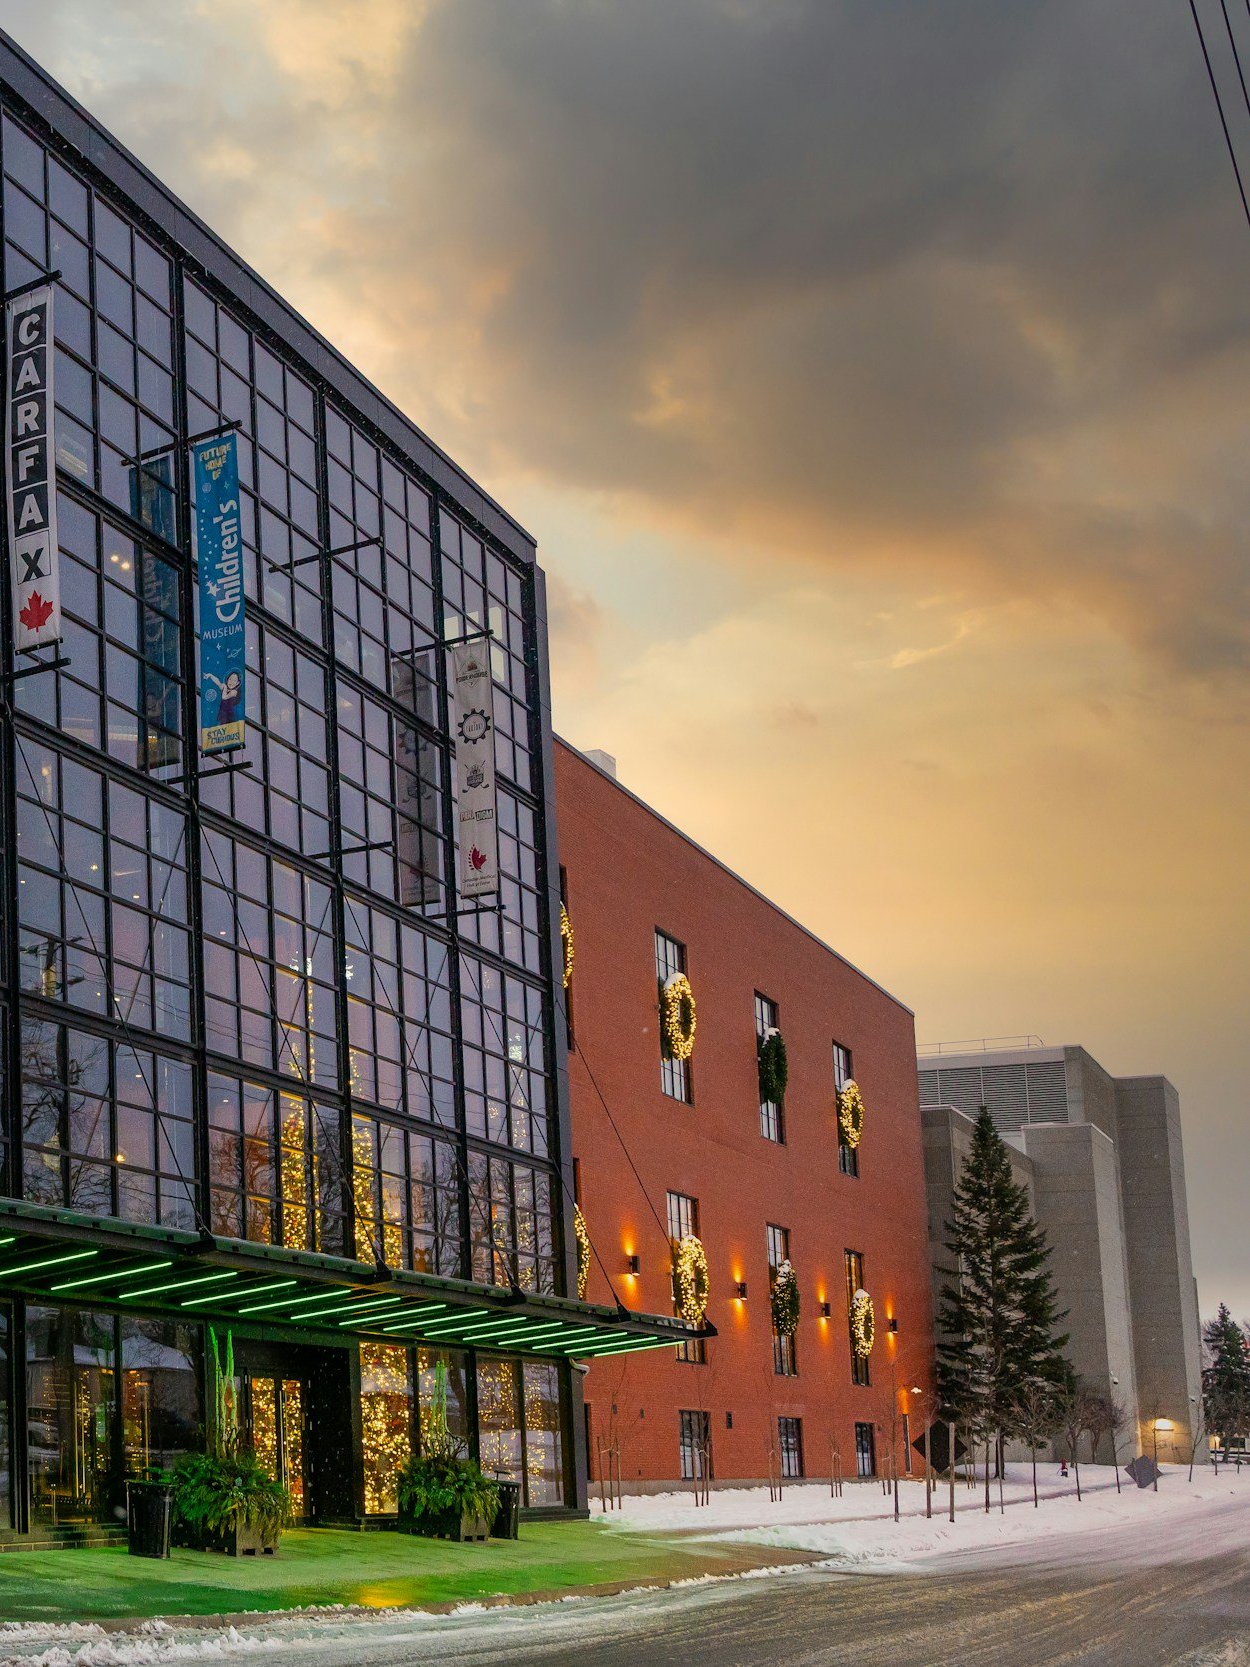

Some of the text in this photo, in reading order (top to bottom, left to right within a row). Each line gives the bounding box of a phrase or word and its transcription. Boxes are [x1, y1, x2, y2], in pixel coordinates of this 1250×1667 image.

[15, 313, 45, 583] CARFAX
[199, 442, 231, 462] FUTURE
[205, 454, 227, 471] HOME
[213, 499, 241, 623] Children's
[202, 623, 243, 641] MUSEUM
[207, 727, 227, 740] STAY
